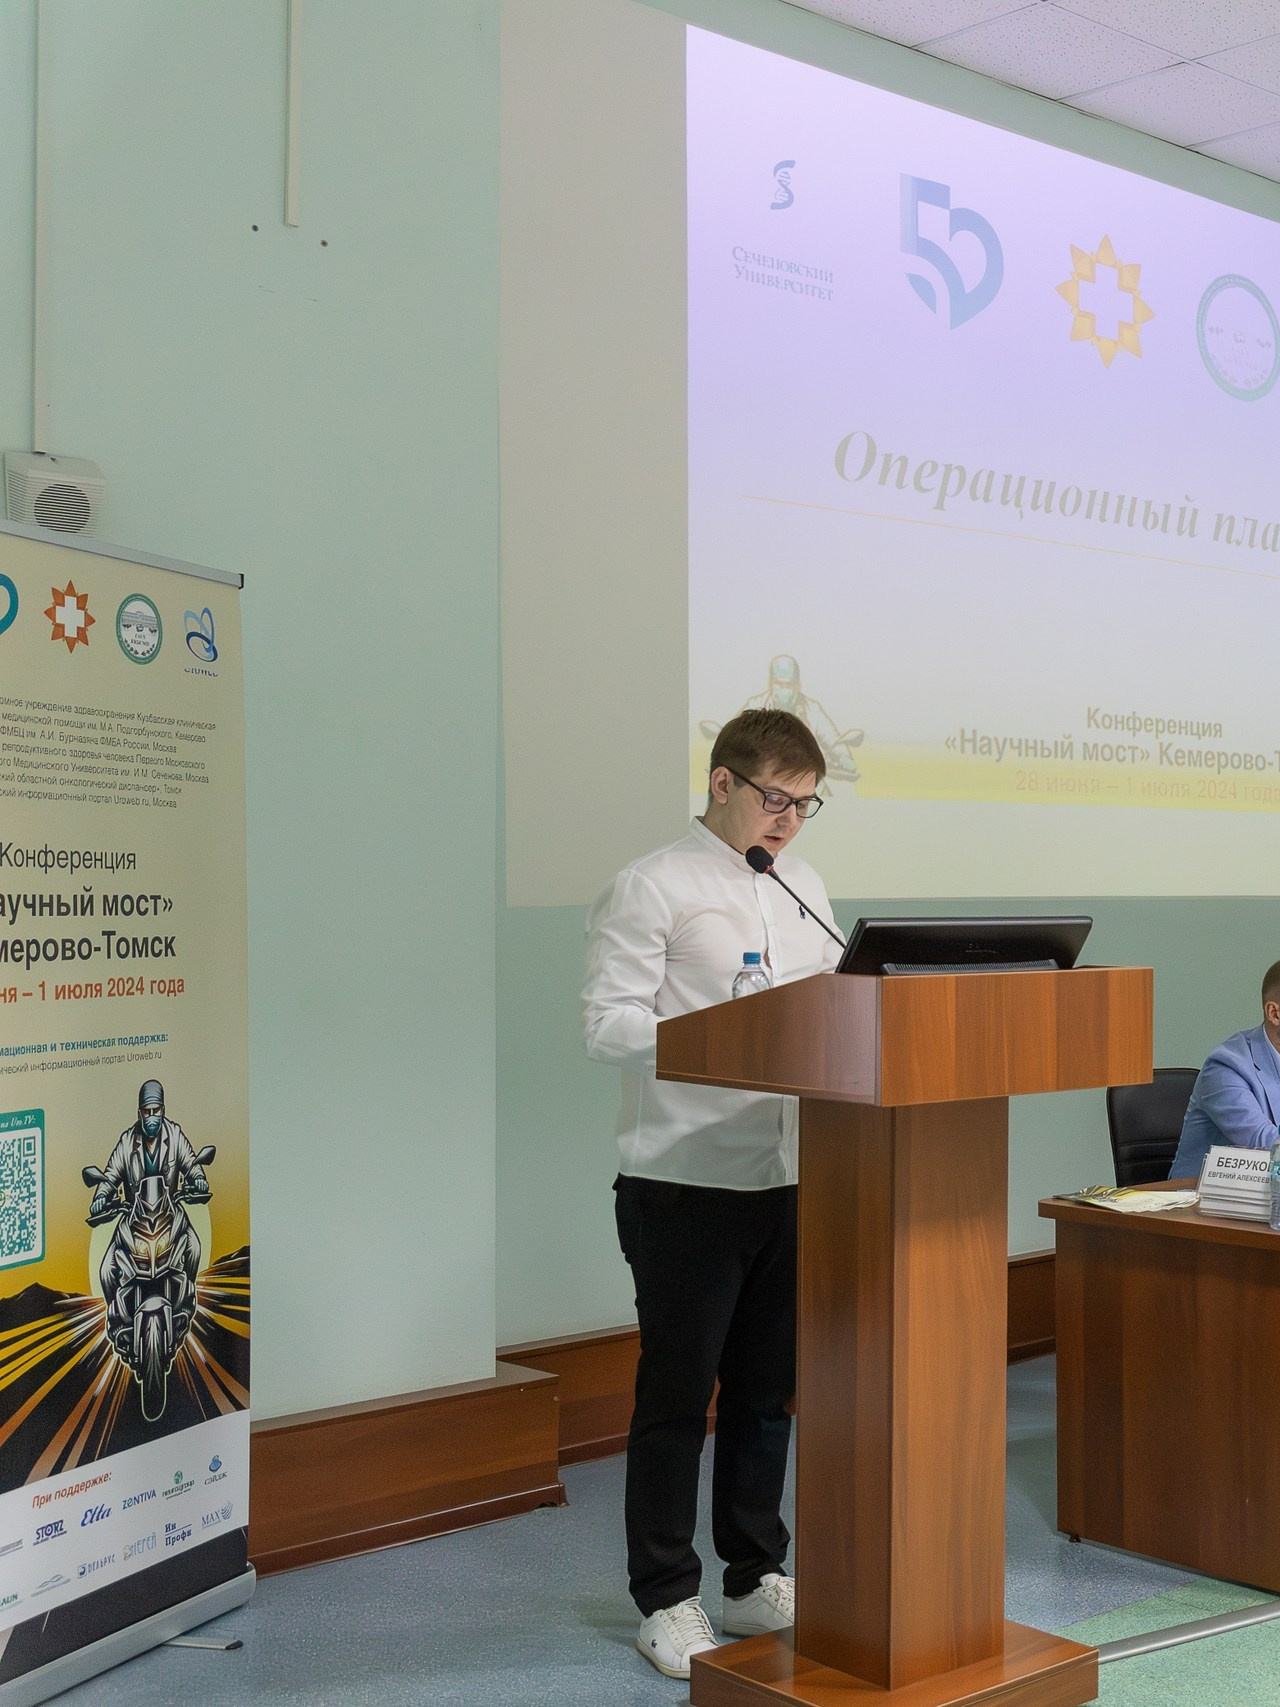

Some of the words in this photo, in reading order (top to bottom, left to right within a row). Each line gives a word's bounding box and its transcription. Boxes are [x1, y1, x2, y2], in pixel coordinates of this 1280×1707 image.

[834, 430, 1200, 538] Операционный
[25, 700, 72, 713] учреждение
[74, 706, 135, 720] здравоохранения
[137, 712, 175, 725] Кузбасская
[1087, 706, 1223, 740] Конференция
[2, 712, 52, 726] медицинской
[54, 718, 85, 729] помощи
[175, 730, 206, 743] Кемерово
[59, 732, 98, 745] Бурназяна
[100, 736, 122, 747] ФМБА
[152, 741, 177, 753] Москва
[945, 728, 1074, 763] «Научный
[1082, 741, 1150, 764] мост»
[2, 743, 67, 757] репродуктивного
[69, 749, 102, 760] здоровья
[103, 752, 134, 763] человека
[136, 754, 164, 766] Первого
[165, 757, 205, 770] Московского
[13, 757, 69, 771] Медицинского
[71, 762, 119, 776] Университета
[185, 773, 209, 784] Москва
[16, 773, 57, 785] областной
[59, 777, 117, 789] онкологический
[164, 784, 182, 794] Томск
[1015, 770, 1039, 791] 28
[1047, 776, 1100, 793] июня
[1141, 781, 1190, 798] июля
[1197, 779, 1237, 800] 2024
[18, 789, 87, 802] информационный
[88, 794, 113, 804] портал
[153, 797, 177, 808] Москва
[0, 842, 136, 875] Конференция
[103, 893, 173, 917] мост»
[38, 980, 46, 1001] 1
[54, 982, 103, 1000] июля
[107, 976, 145, 997] 2024
[150, 978, 185, 997] года
[50, 1043, 57, 1052] и
[60, 1038, 116, 1051] техническая
[117, 1033, 169, 1046] поддержка:
[30, 1056, 100, 1072] информационный
[102, 1054, 125, 1066] портал
[127, 1051, 162, 1062] Uroweb.ru
[1207, 1170, 1237, 1180] ЕВГЕНИЙ
[32, 1493, 52, 1509] При
[54, 1472, 112, 1501] поддержке:
[36, 1519, 64, 1540] STORZ
[201, 1510, 221, 1526] MAX
[165, 1529, 192, 1547] Профи
